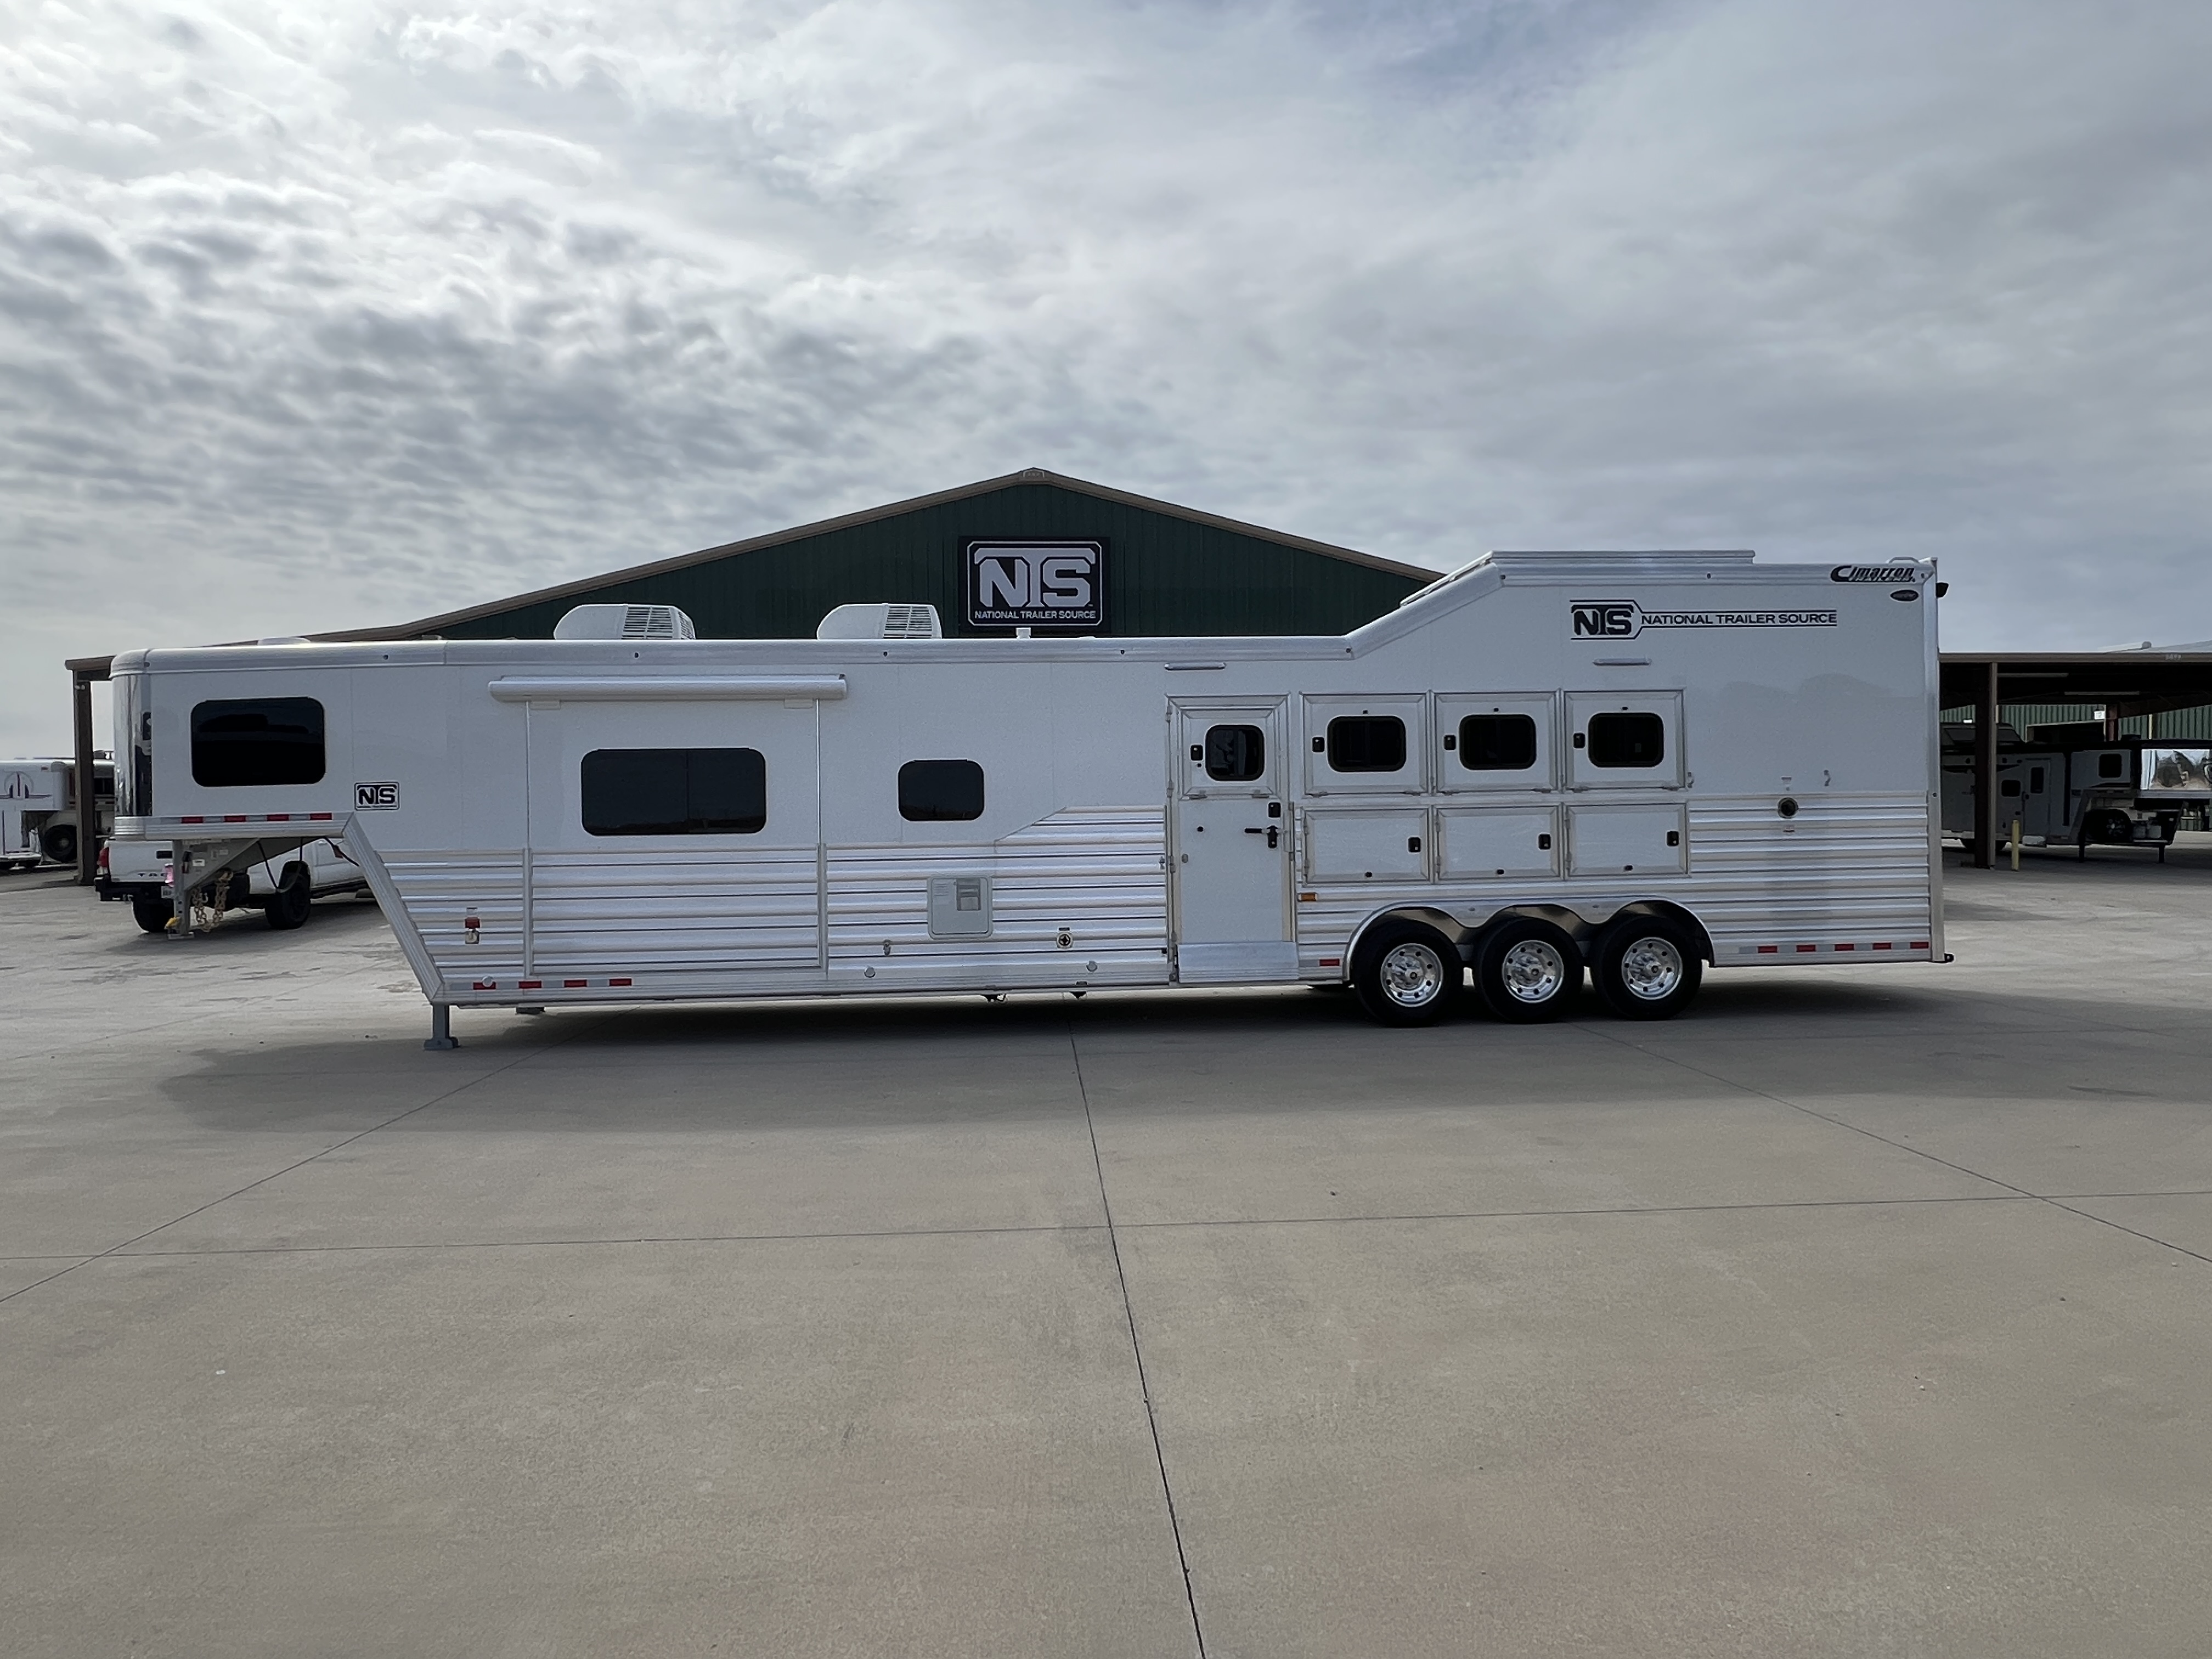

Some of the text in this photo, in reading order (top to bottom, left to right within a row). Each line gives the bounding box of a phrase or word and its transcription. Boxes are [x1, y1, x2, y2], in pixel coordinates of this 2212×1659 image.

[974, 548, 1096, 607] NTS
[1831, 566, 1915, 582] Cimarron
[974, 610, 1096, 619] NATIONAL TRAILER SOURCE
[1571, 605, 1634, 635] NTS
[1641, 613, 1837, 624] NATIONAL TRAILER SOURCE
[357, 785, 397, 805] NTS
